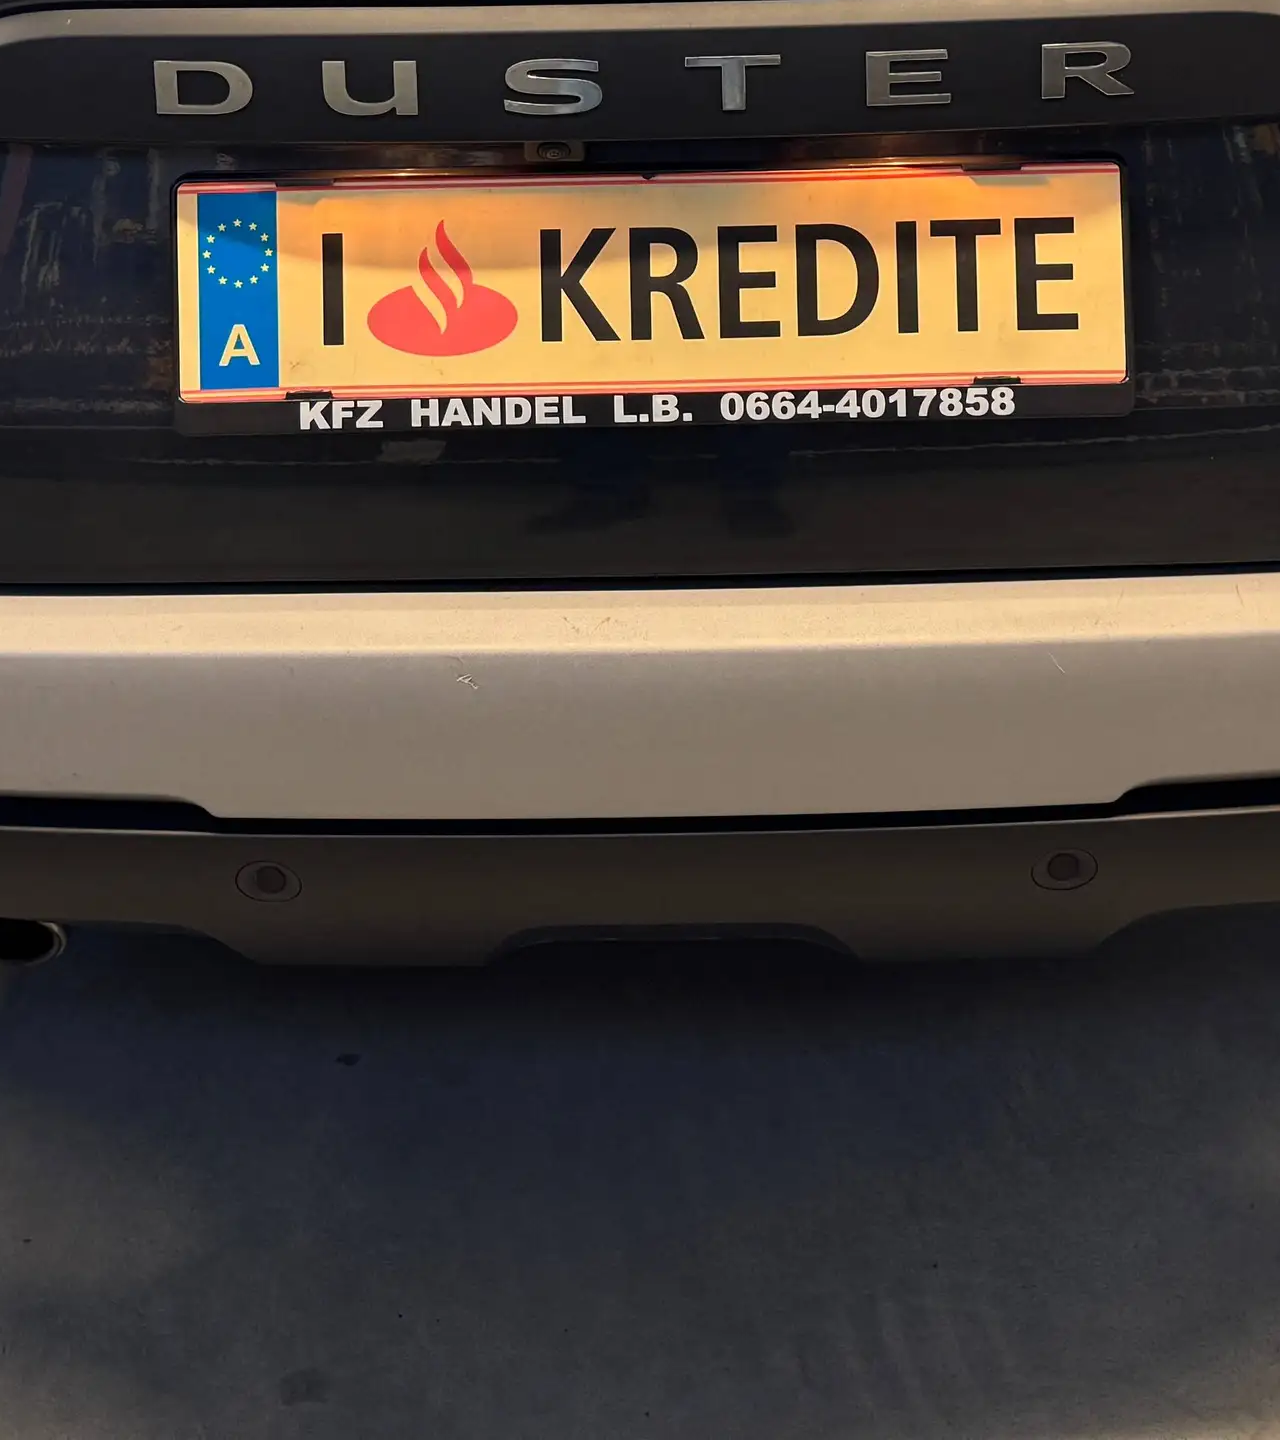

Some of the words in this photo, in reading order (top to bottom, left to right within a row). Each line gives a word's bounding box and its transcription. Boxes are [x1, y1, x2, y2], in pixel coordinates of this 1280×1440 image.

[153, 41, 1135, 116] DUSTER
[321, 232, 346, 346] I
[539, 216, 1080, 343] KREDITE
[219, 323, 261, 367] A
[299, 400, 384, 430] KFZ
[410, 395, 587, 428] HANDEL
[613, 393, 694, 424] L.B.
[719, 387, 1017, 422] 0664-4017858
